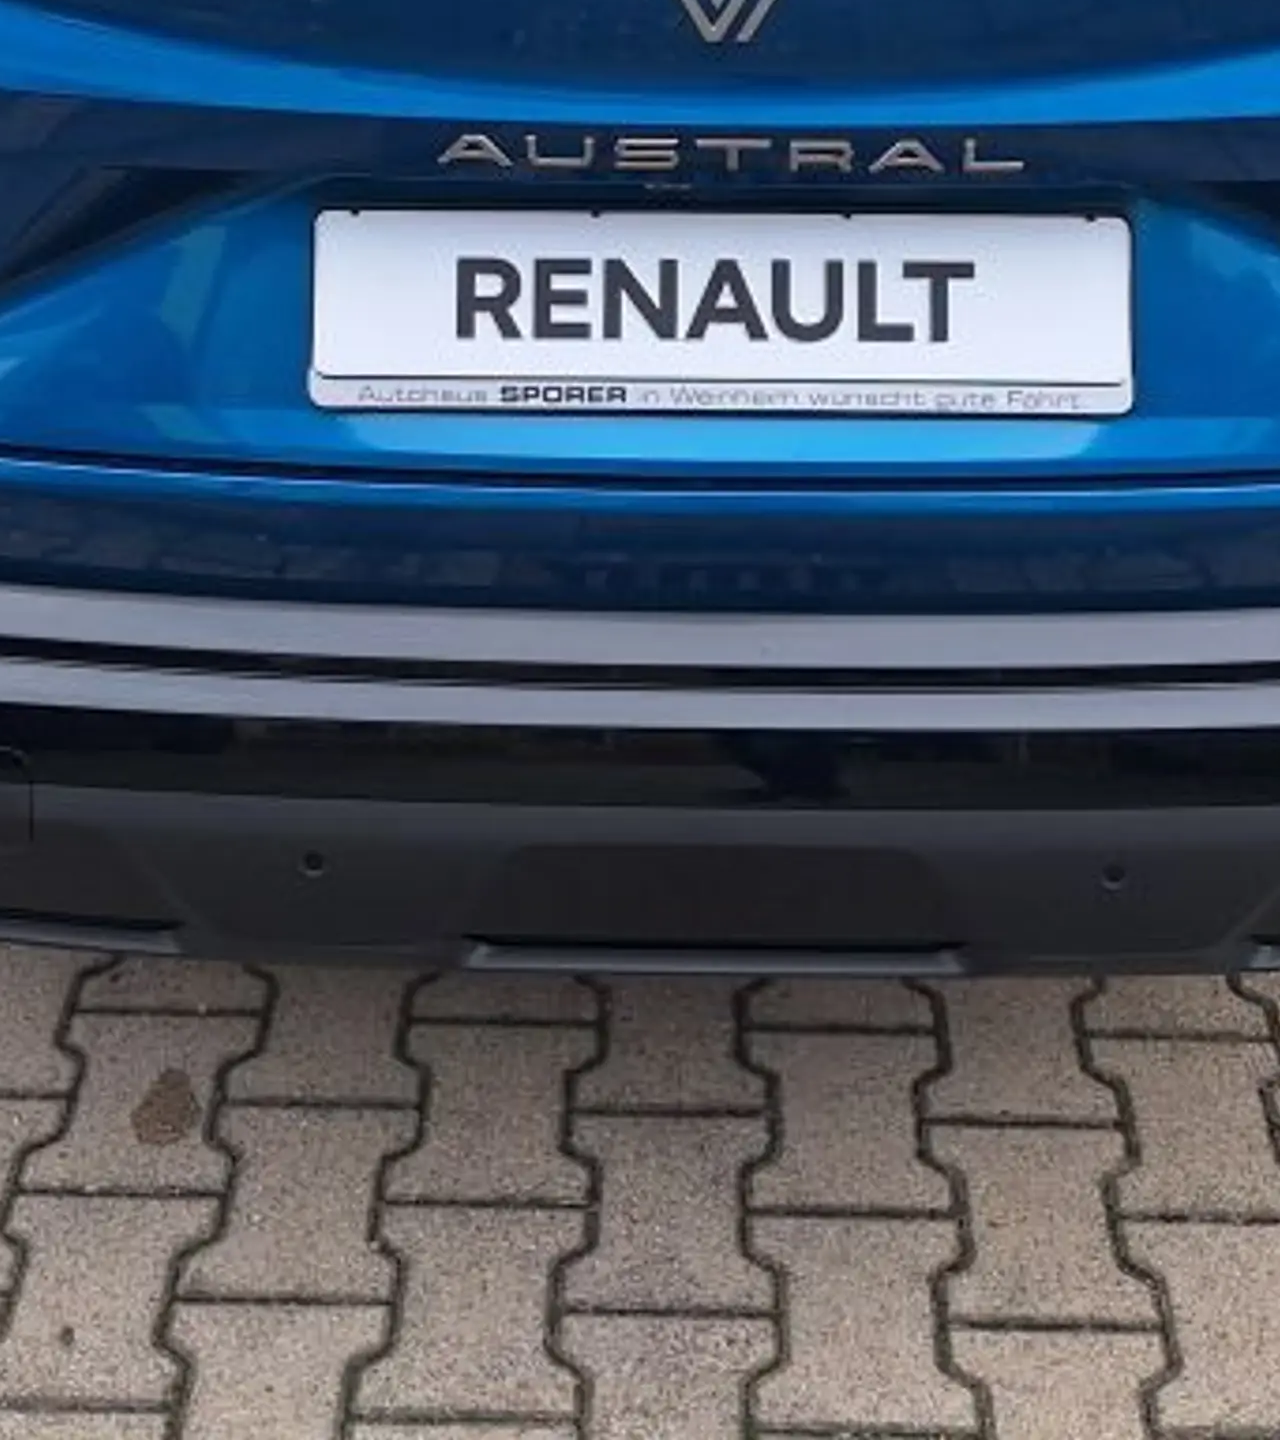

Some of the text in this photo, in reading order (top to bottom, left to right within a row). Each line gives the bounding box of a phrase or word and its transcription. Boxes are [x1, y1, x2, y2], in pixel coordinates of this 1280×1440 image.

[436, 134, 1025, 173] AUSTRAL
[455, 257, 976, 343] RENAULT
[358, 385, 489, 403] Autohaus
[500, 385, 628, 404] SPORER
